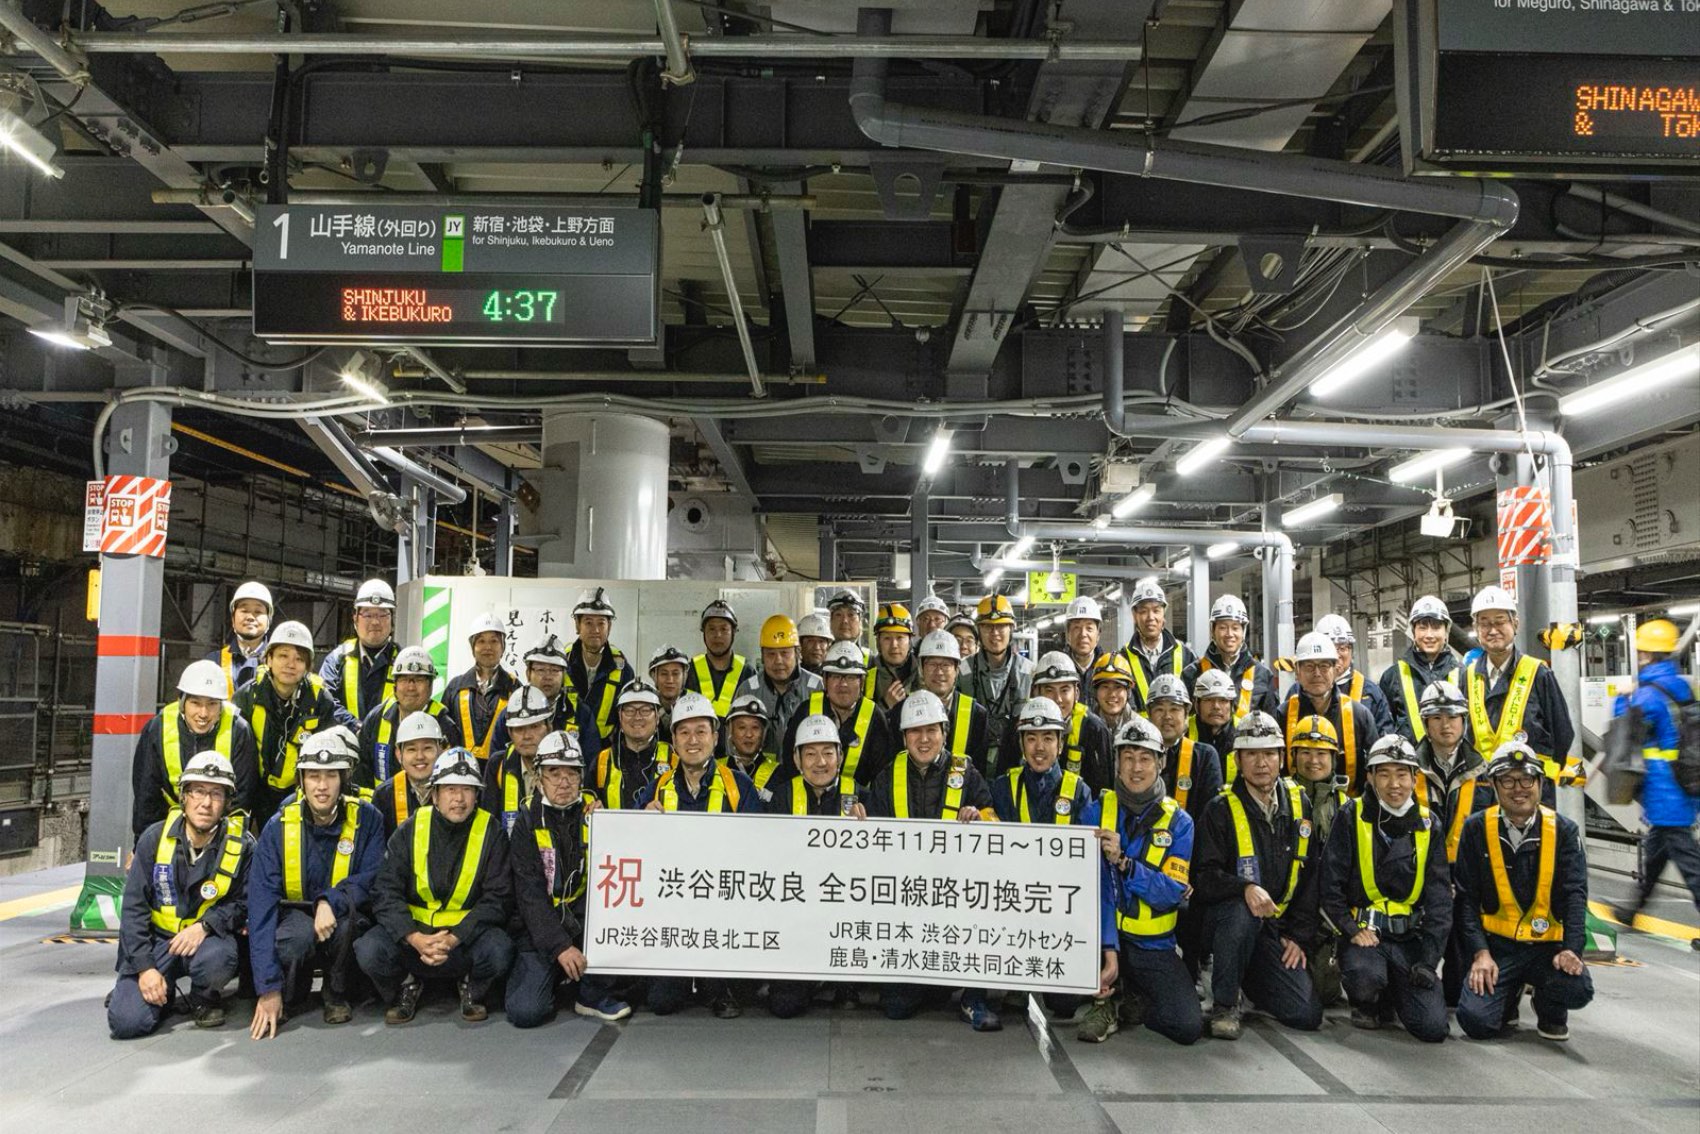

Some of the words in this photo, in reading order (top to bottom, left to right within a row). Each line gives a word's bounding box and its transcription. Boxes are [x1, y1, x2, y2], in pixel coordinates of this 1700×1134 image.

[1517, 0, 1576, 12] Meguro,
[1580, 0, 1660, 13] Shinagawa
[1575, 112, 1593, 135] &
[447, 220, 462, 233] JY
[473, 216, 615, 234] 新宿・池袋・上野方面
[272, 213, 290, 259] 1
[472, 235, 485, 245] for
[488, 235, 529, 247] Shinjuku,
[532, 236, 577, 246] Ikebukuro
[579, 237, 587, 246] &
[589, 237, 614, 247] Ueno
[341, 241, 404, 255] Yamanote
[408, 242, 435, 255] Line
[343, 289, 426, 305] SHINJUKU
[483, 290, 557, 321] 4:37
[344, 306, 356, 321] &
[361, 306, 452, 322] IKEBUKURO
[111, 498, 134, 508] STOP
[597, 854, 644, 908] 祝
[658, 867, 806, 903] 渋谷駅改良
[819, 872, 1082, 915] 全5回線路切換完了
[595, 925, 781, 951] JR渋谷駅改良北工区
[829, 920, 914, 941] JR東日本
[829, 947, 1066, 980] 鹿島・清水建設共同企業体
